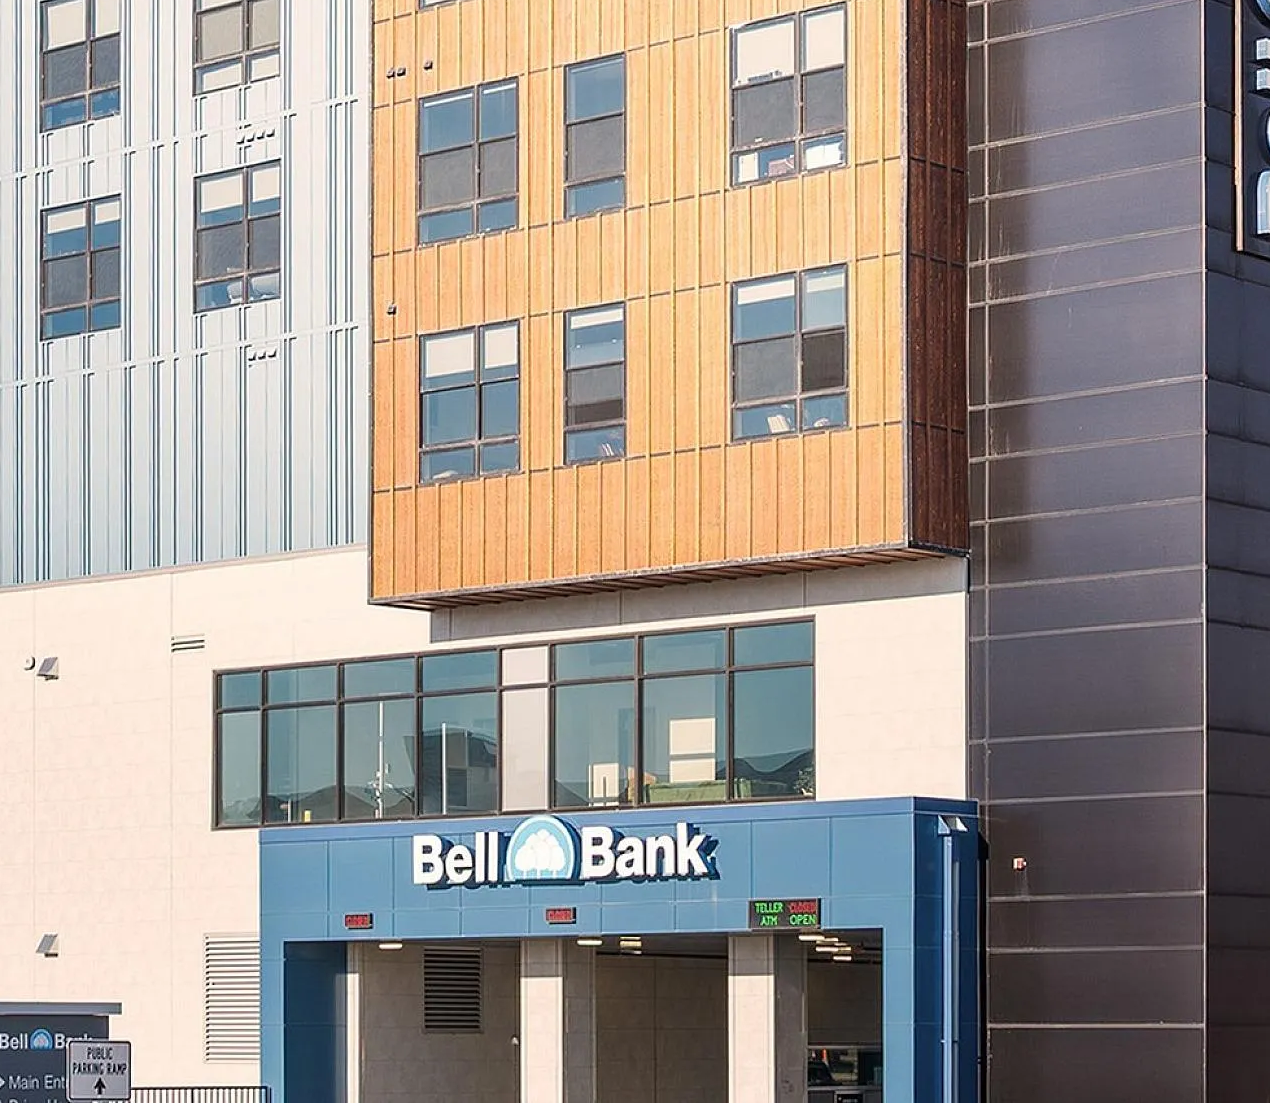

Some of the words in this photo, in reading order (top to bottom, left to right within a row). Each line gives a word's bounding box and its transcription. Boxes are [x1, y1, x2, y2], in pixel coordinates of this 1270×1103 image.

[412, 831, 499, 885] Bell
[581, 822, 709, 879] Bank
[755, 901, 783, 913] TELLER
[760, 915, 778, 926] ATM
[789, 914, 816, 925] OPEN
[86, 1047, 113, 1060] PUBLIC
[73, 1062, 104, 1075] PARKING
[8, 1075, 40, 1090] Main
[44, 1075, 65, 1090] Ent
